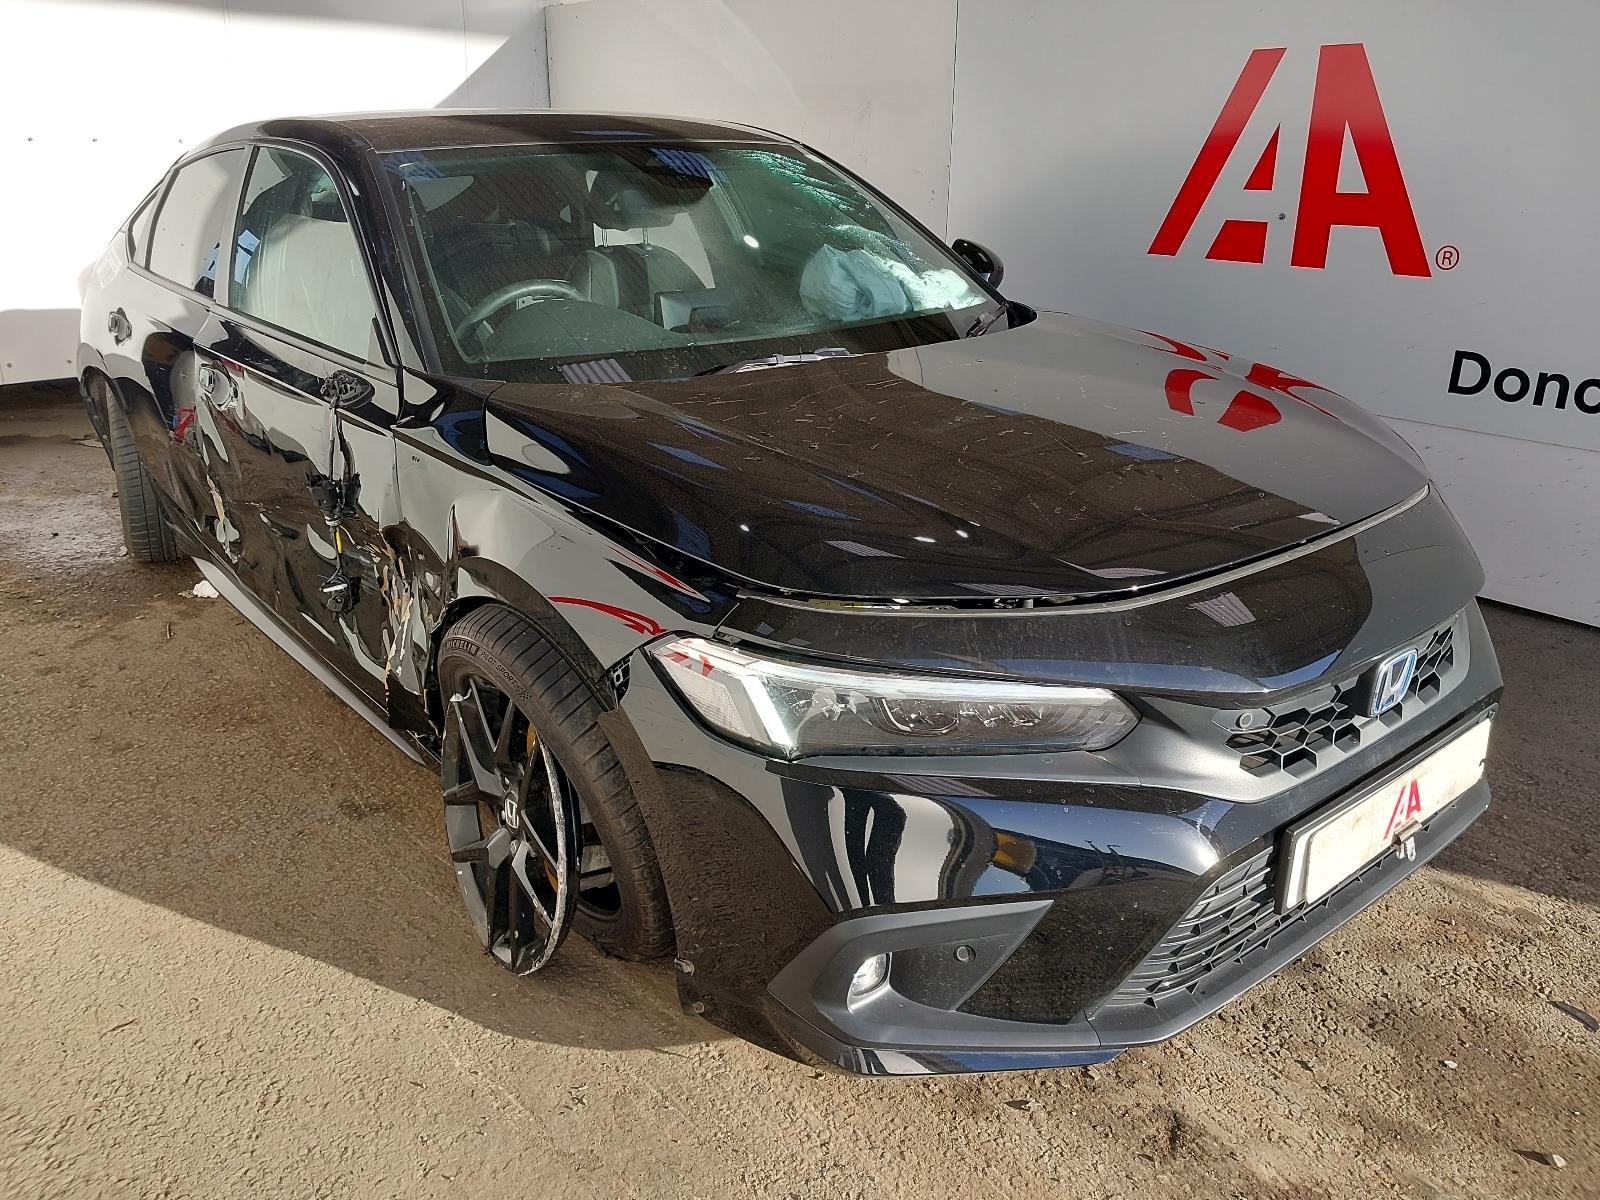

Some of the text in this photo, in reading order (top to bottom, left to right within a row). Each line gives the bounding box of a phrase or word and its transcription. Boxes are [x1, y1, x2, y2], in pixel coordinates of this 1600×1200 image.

[1448, 350, 1600, 414] Donc
[480, 651, 518, 685] PILOT SPORT
